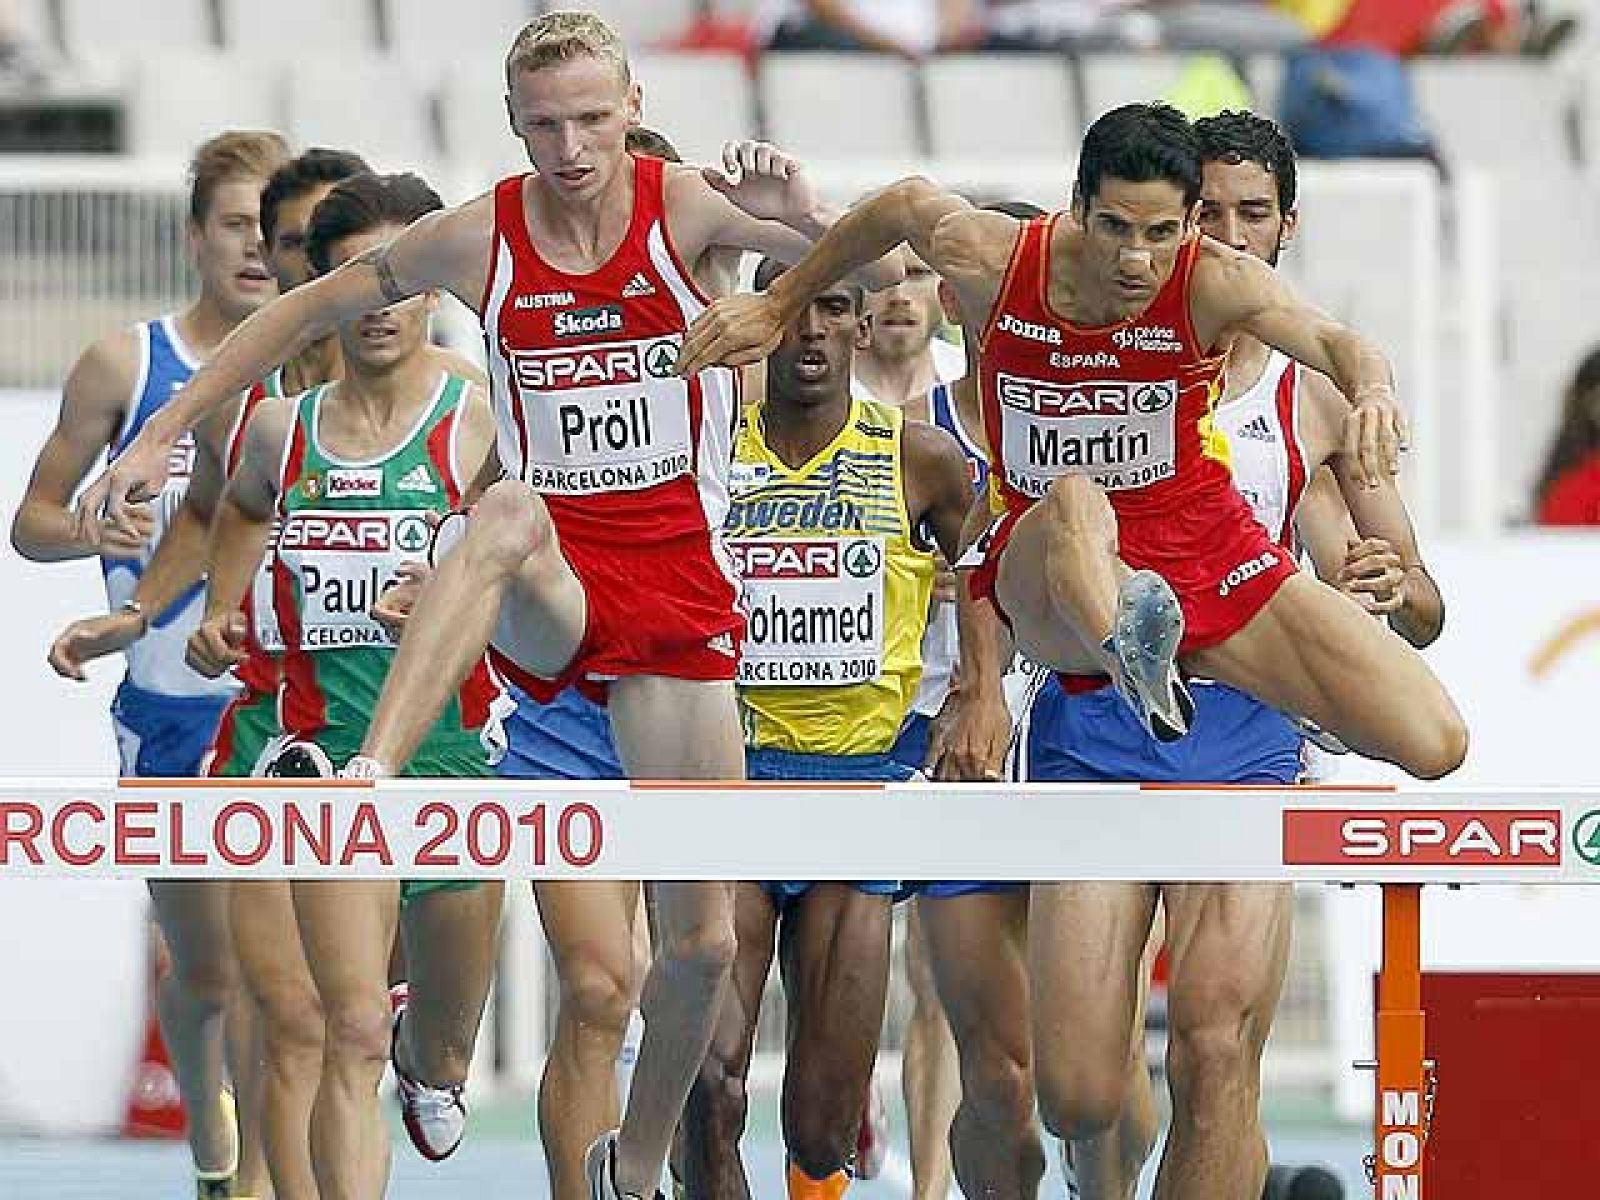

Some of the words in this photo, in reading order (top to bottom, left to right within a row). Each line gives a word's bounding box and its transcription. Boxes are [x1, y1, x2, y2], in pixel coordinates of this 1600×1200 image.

[514, 292, 576, 310] AUSTRIA
[999, 314, 1063, 345] Joma
[517, 351, 640, 387] SPAR
[1049, 351, 1121, 369] ESPAÑA
[1001, 384, 1127, 413] SPAR
[559, 397, 651, 455] Pröll
[1028, 424, 1149, 466] Martín
[531, 465, 646, 490] BARCELONA
[651, 454, 689, 478] 2010
[1130, 461, 1169, 485] 2010
[284, 520, 389, 546] SPAR
[1218, 551, 1281, 596] Joma
[744, 591, 874, 644] ohamed
[840, 658, 877, 679] 2010
[413, 800, 603, 866] 2010
[1340, 819, 1558, 857] SPAR
